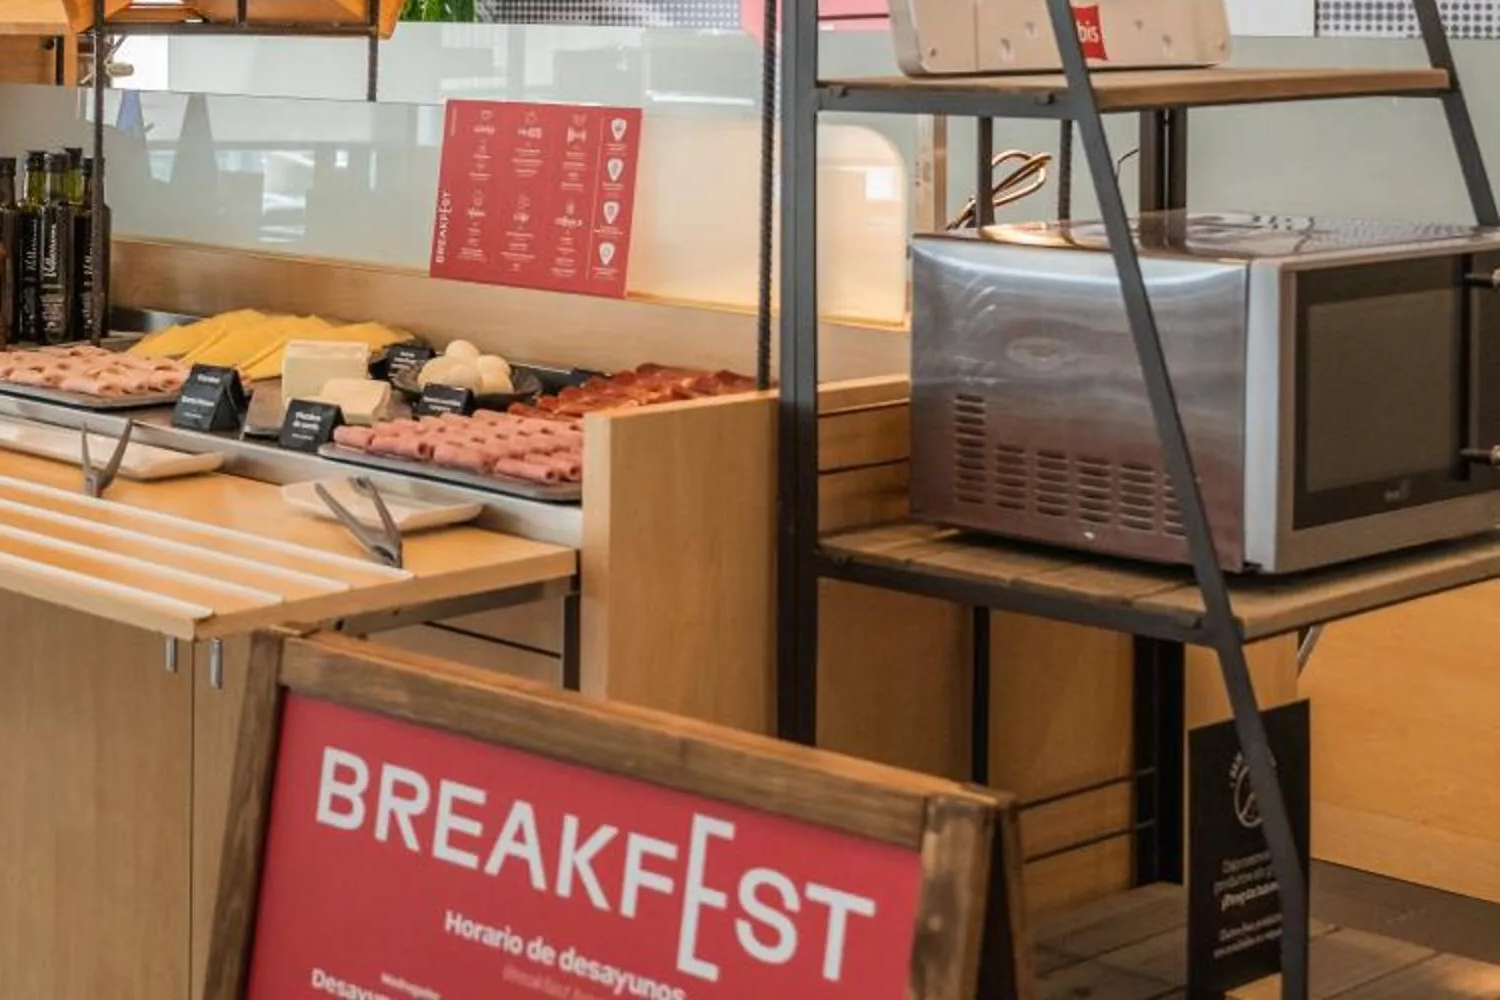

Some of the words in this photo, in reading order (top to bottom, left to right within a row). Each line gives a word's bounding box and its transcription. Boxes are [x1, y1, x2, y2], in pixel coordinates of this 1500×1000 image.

[1076, 19, 1100, 43] bis
[315, 745, 876, 983] BREAKFEST
[444, 908, 524, 956] Horario
[526, 936, 555, 966] de
[558, 942, 687, 1000] desayunos
